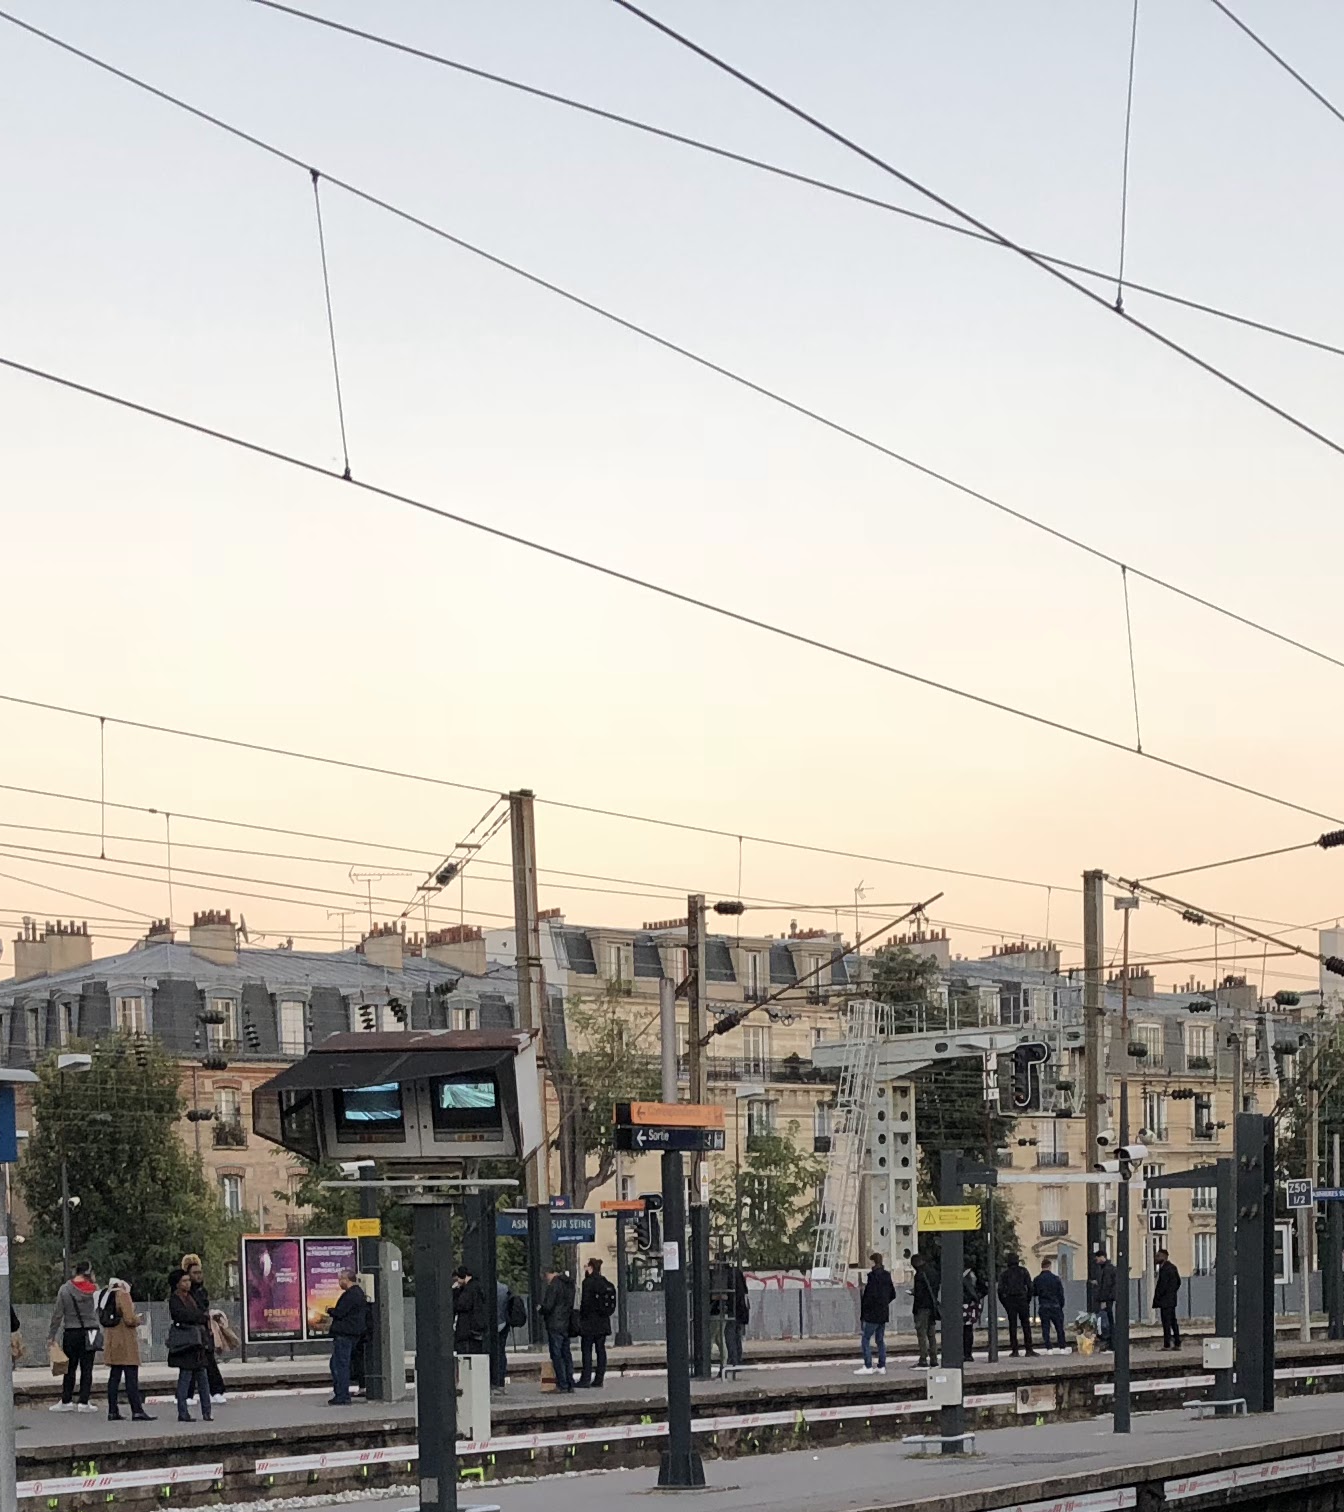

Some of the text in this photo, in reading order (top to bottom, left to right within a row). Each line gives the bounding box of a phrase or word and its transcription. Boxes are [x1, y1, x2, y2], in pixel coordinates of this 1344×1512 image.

[648, 1128, 670, 1141] Sortie
[551, 1219, 592, 1229] SUR SEINE
